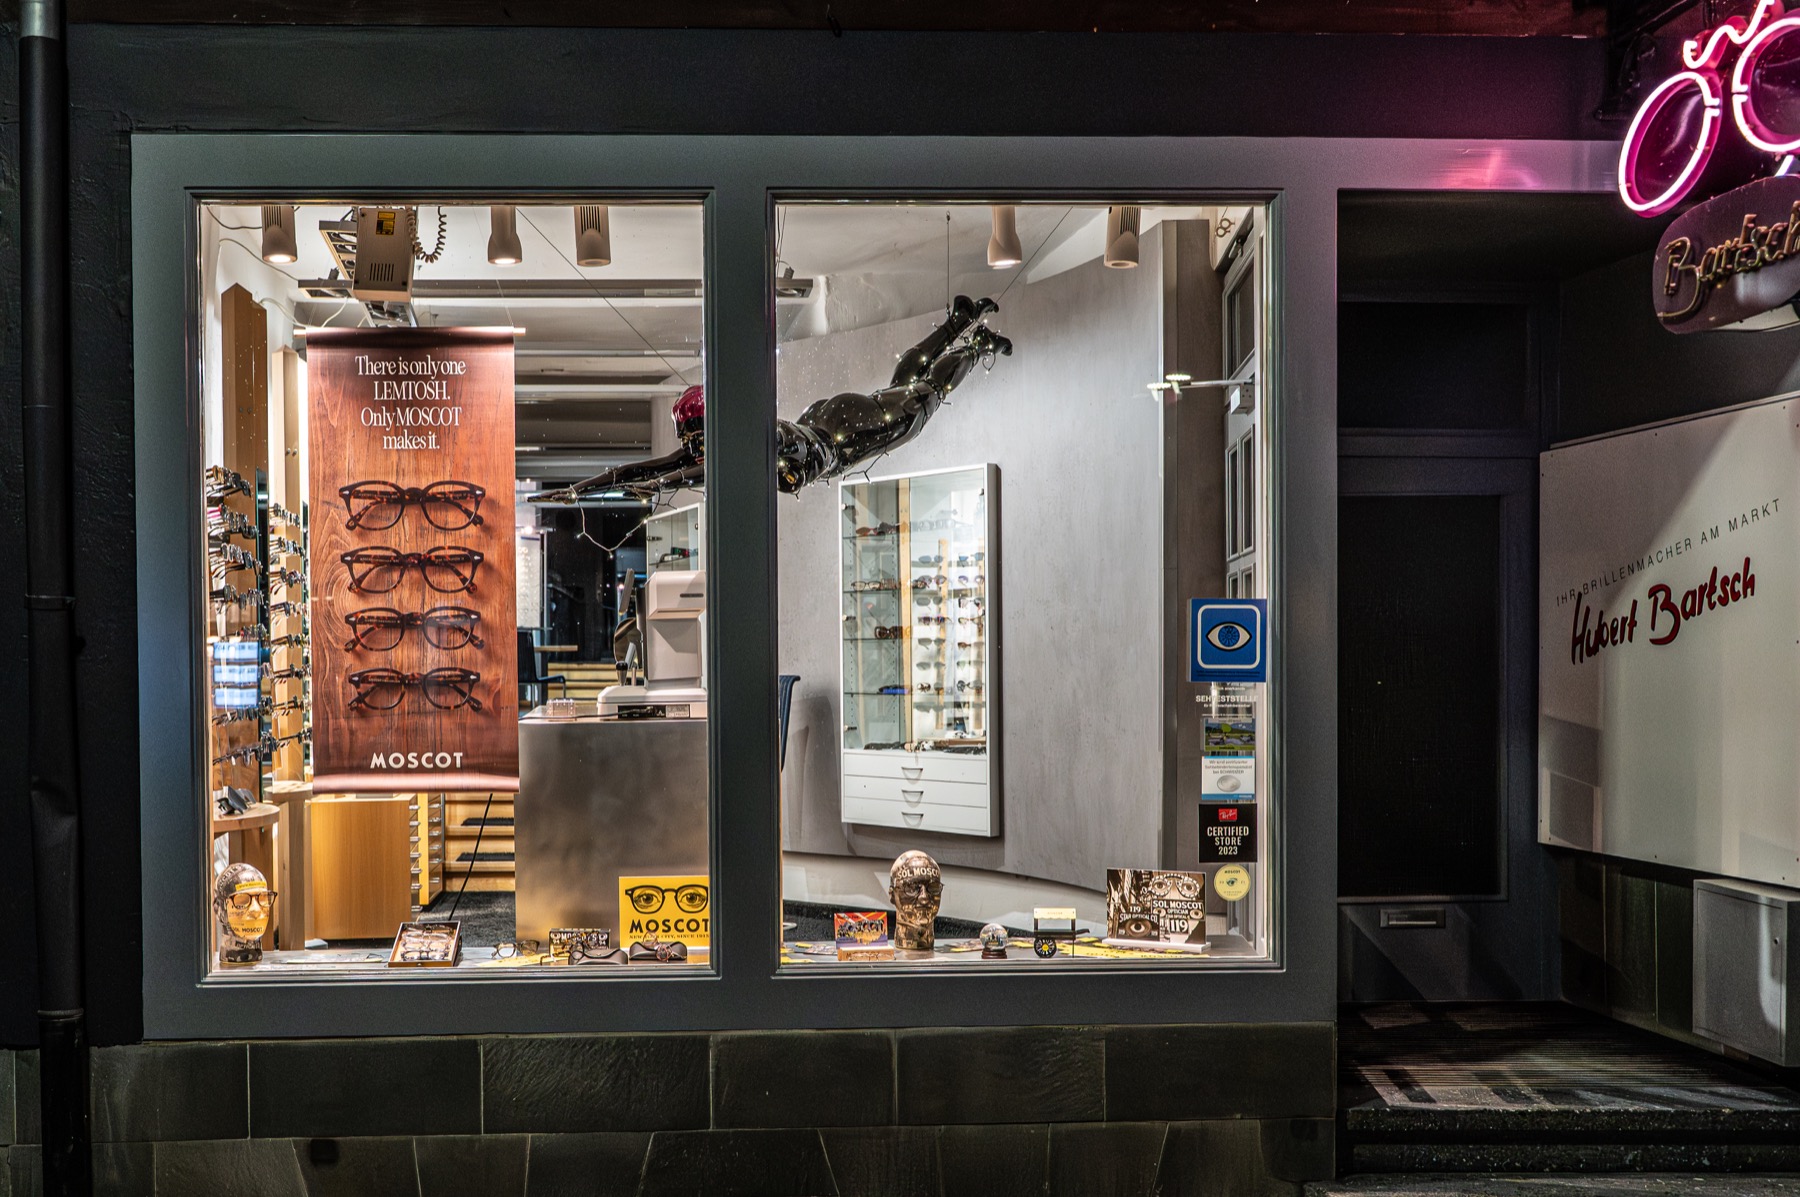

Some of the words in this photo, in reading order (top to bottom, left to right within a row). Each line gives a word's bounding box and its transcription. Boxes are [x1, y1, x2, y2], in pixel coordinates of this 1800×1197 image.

[355, 355, 396, 376] There
[398, 356, 408, 376] is
[410, 355, 438, 379] only
[440, 361, 466, 376] one
[374, 380, 451, 400] LEMTOSH.
[360, 406, 396, 430] Only
[396, 406, 462, 427] MOSCOT
[383, 430, 426, 450] makes
[427, 430, 440, 450] it.
[1556, 588, 1576, 607] IHR
[1582, 537, 1693, 596] BRILLENMACHER
[1700, 525, 1720, 545] AM
[1728, 498, 1780, 532] MARKT
[1571, 591, 1638, 666] Hubert
[1648, 557, 1756, 646] Bartsch
[370, 752, 464, 768] MOSCOT
[1207, 826, 1250, 836] CERTIFIED
[1214, 836, 1242, 846] STORE
[1218, 846, 1238, 855] 2023
[897, 869, 913, 880] SOL
[1153, 900, 1169, 908] SOL
[1170, 901, 1202, 910] MOSCOT
[630, 918, 709, 933] MOSCOT
[1170, 920, 1189, 932] 119
